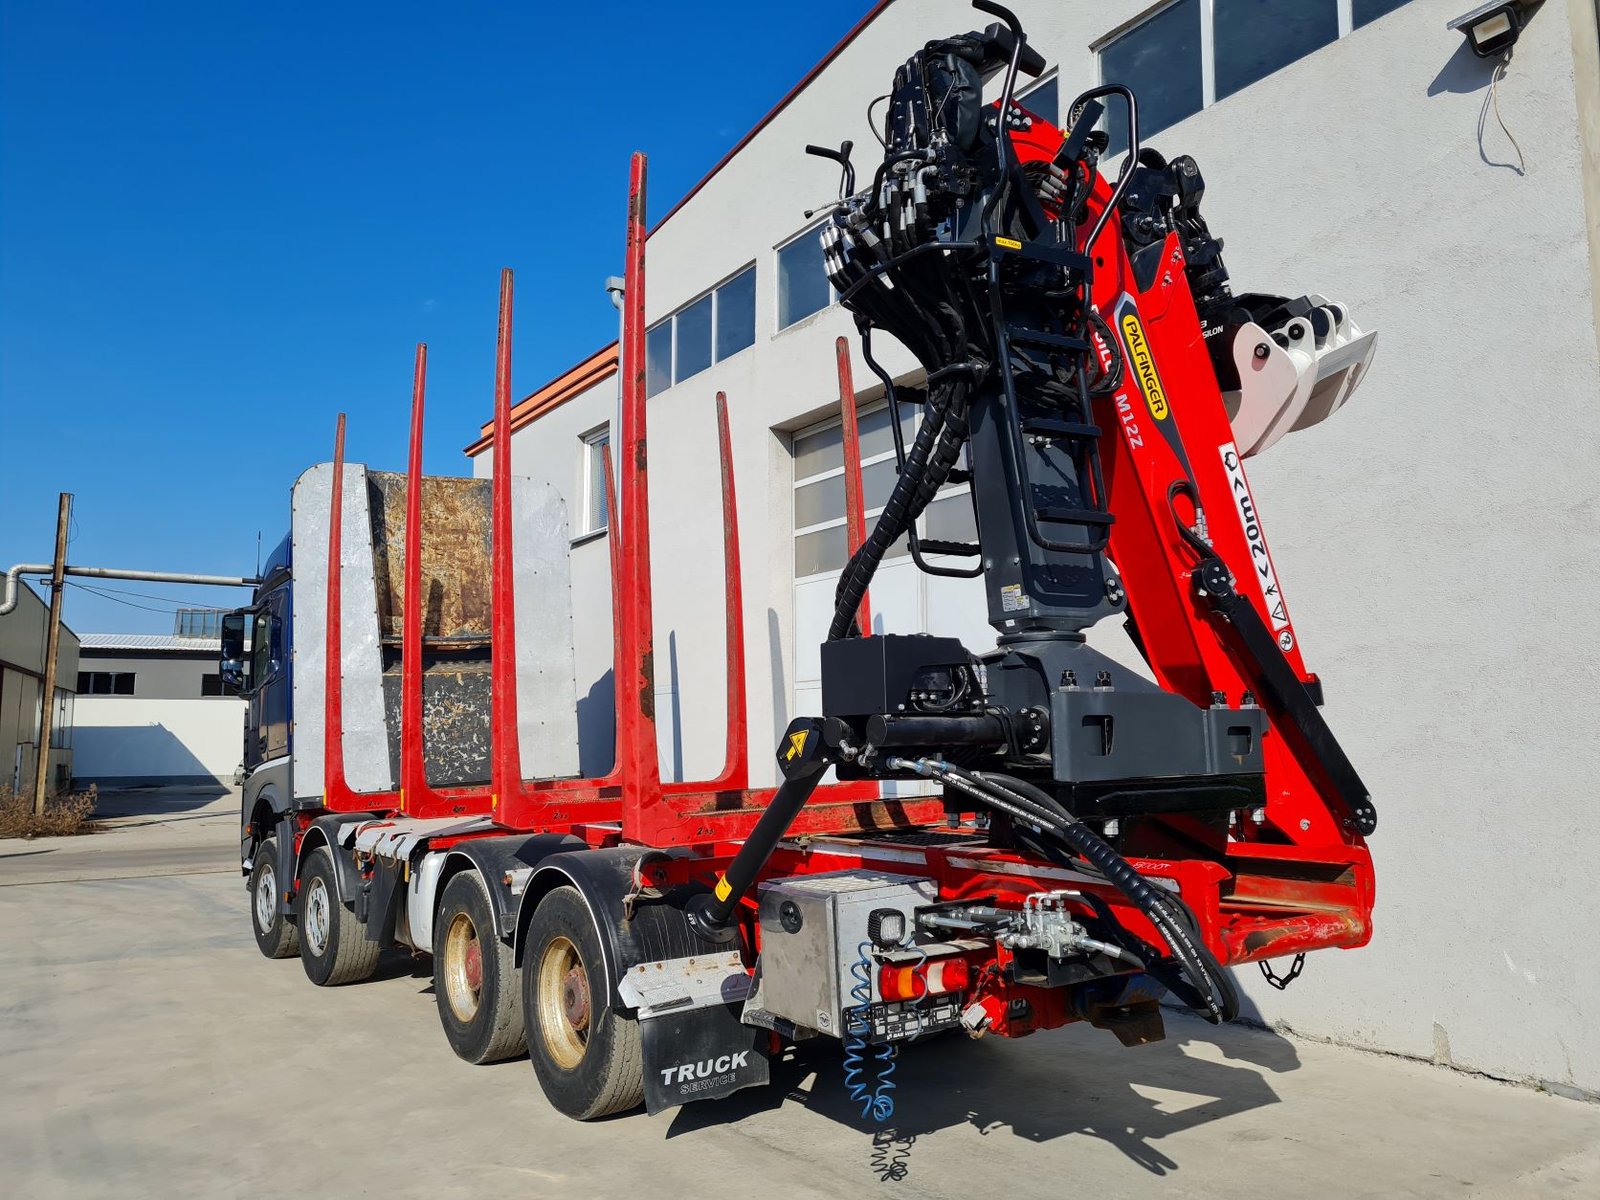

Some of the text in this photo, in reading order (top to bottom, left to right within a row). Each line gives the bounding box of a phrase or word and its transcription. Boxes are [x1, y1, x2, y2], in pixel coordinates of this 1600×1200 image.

[1202, 324, 1224, 339] SILON
[1126, 321, 1164, 414] PALFINGER
[1115, 393, 1144, 450] M12Z
[661, 1050, 750, 1086] TRUCK
[680, 1072, 736, 1095] SERVICE
